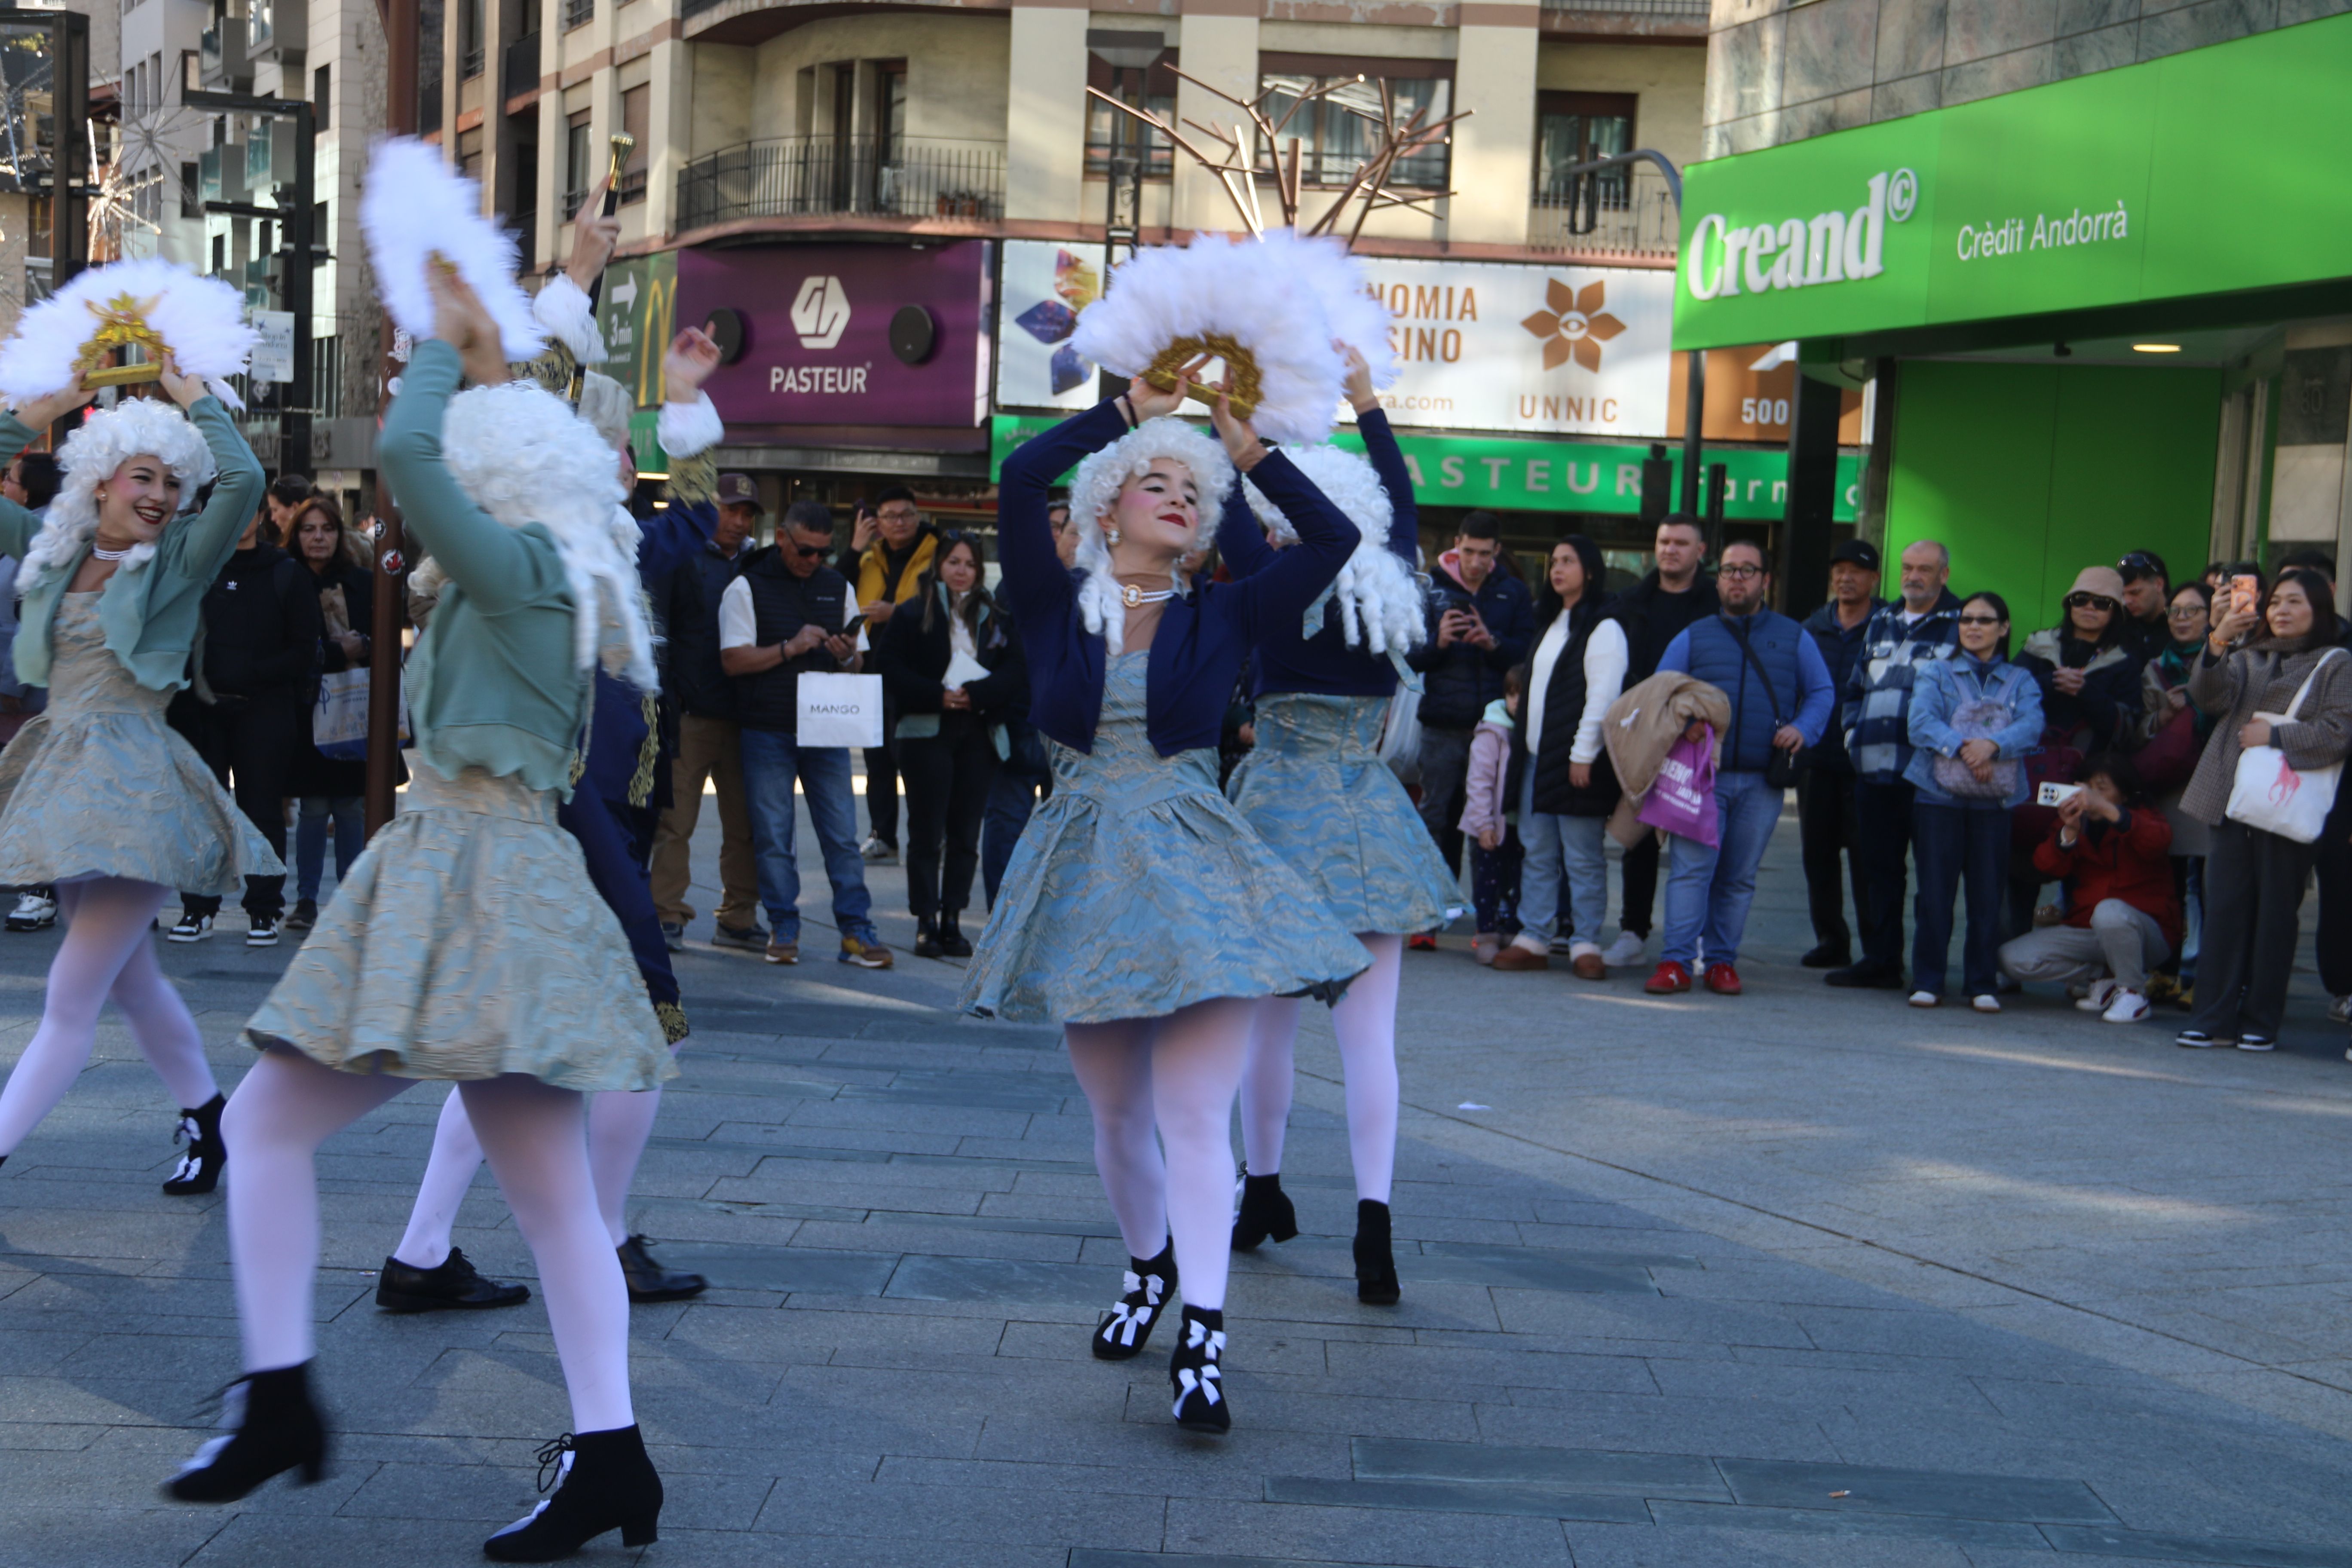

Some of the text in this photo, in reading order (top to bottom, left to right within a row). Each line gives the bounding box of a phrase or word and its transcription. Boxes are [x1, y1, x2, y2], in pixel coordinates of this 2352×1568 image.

[1688, 172, 1888, 300] Creand
[1957, 199, 2128, 261] Crèdit Andorrà
[609, 313, 619, 348] 3
[770, 366, 867, 393] PASTEUR
[1520, 394, 1617, 423] UNNIC
[1741, 397, 1789, 426] 500
[810, 704, 860, 715] MANGO
